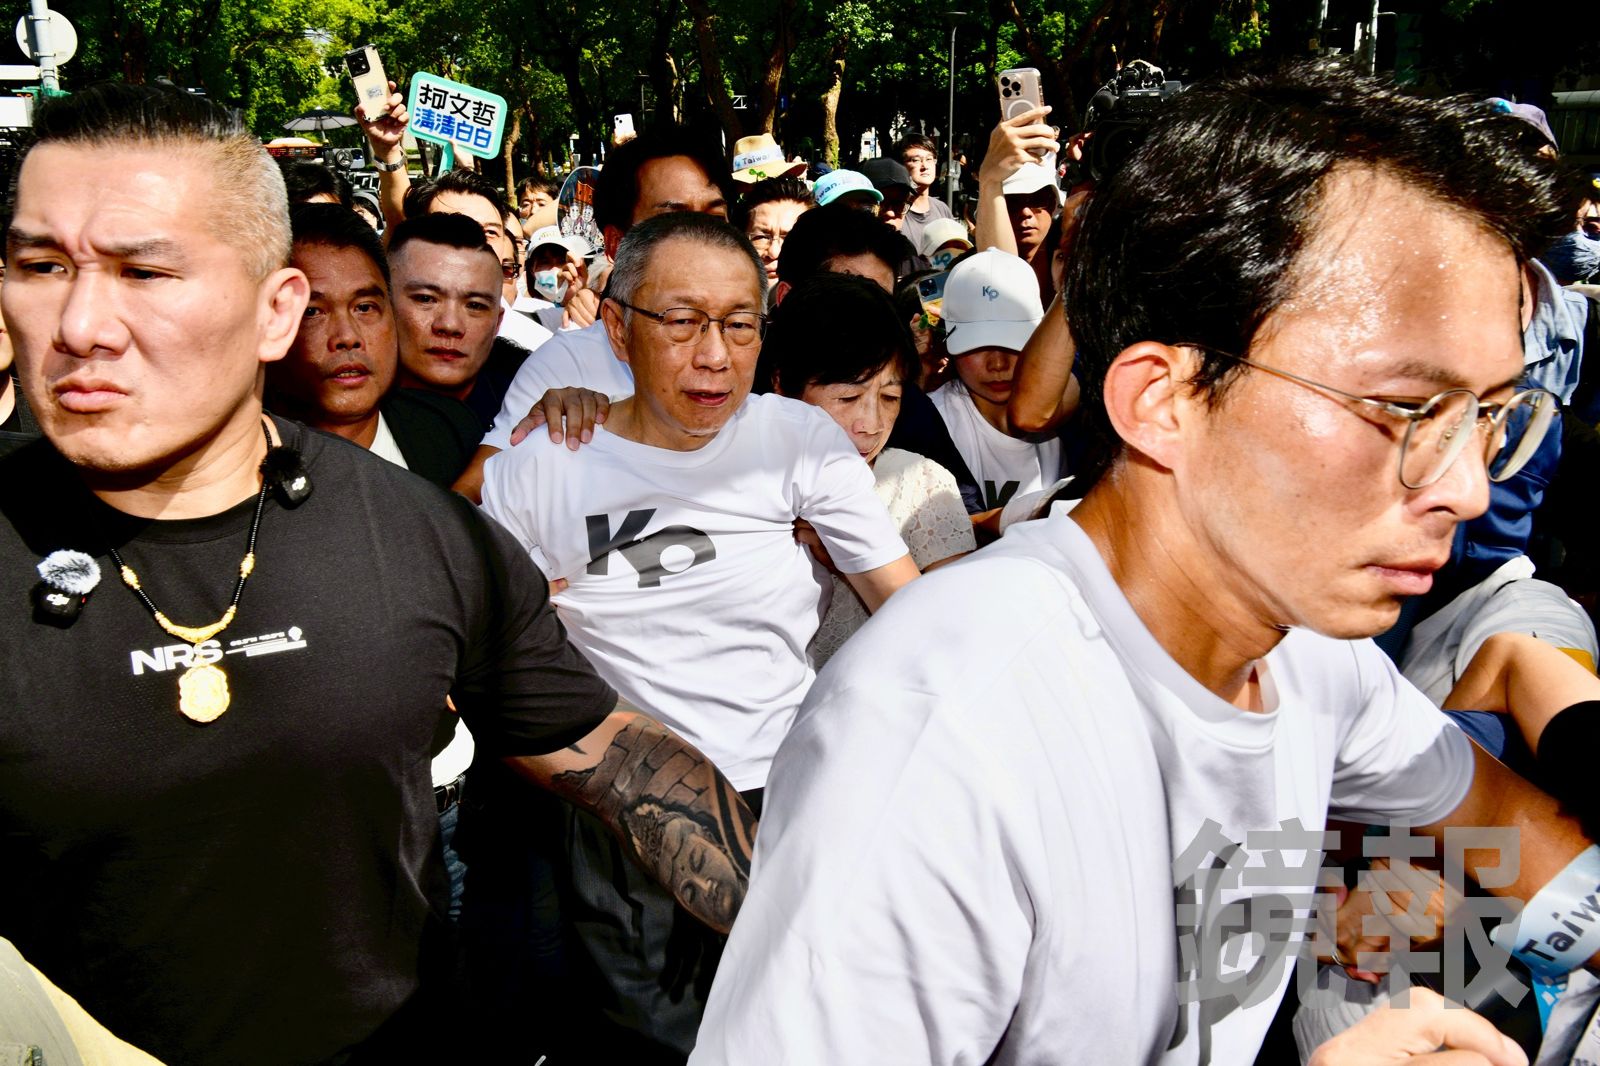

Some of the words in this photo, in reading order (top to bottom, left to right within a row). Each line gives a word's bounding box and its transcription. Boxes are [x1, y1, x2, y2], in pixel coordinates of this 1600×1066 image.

[419, 84, 496, 127] 柯文哲
[413, 107, 492, 149] 清清白白
[742, 154, 769, 165] Taiwa
[130, 640, 224, 676] NRS
[1518, 885, 1600, 963] Taiw
